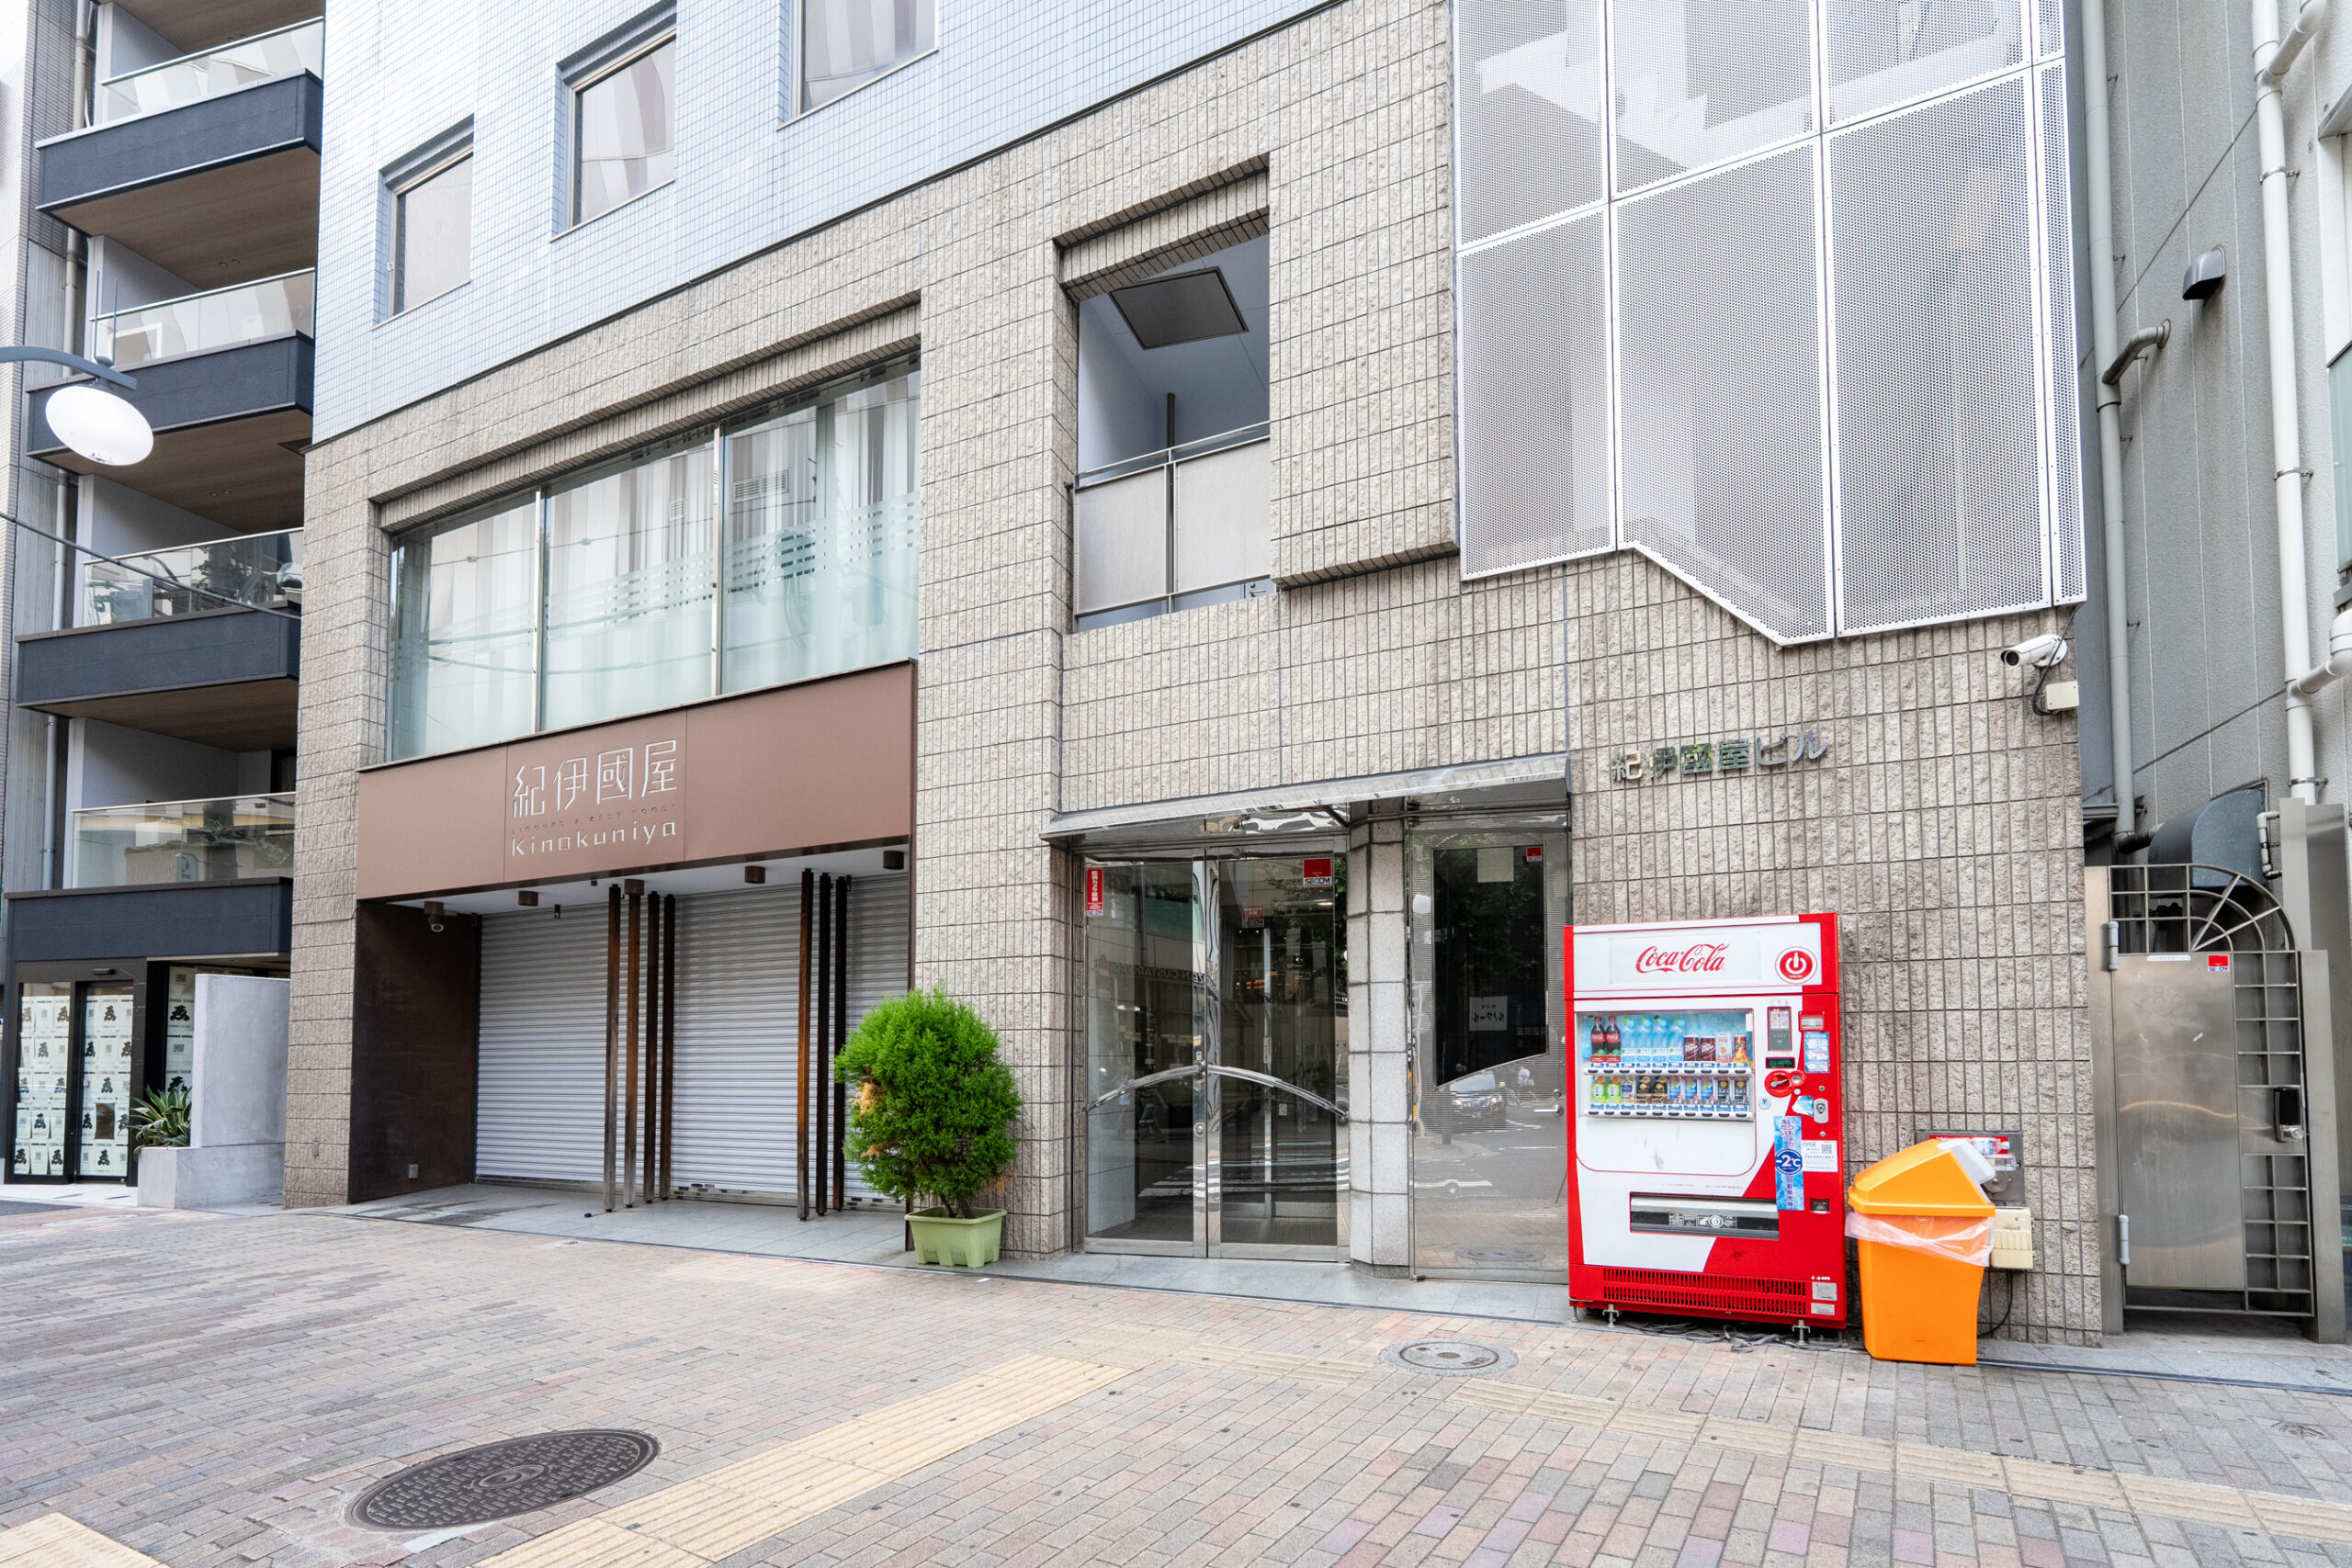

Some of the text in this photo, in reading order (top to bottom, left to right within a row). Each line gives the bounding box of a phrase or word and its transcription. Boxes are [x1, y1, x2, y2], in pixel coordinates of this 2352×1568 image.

[1611, 730, 1827, 782] 紀伊國屋ビル
[513, 739, 677, 818] 紀伊國屋
[512, 820, 676, 857] Kinokuniya
[1305, 877, 1330, 886] SECOM
[1636, 942, 1731, 973] Coca-Cola
